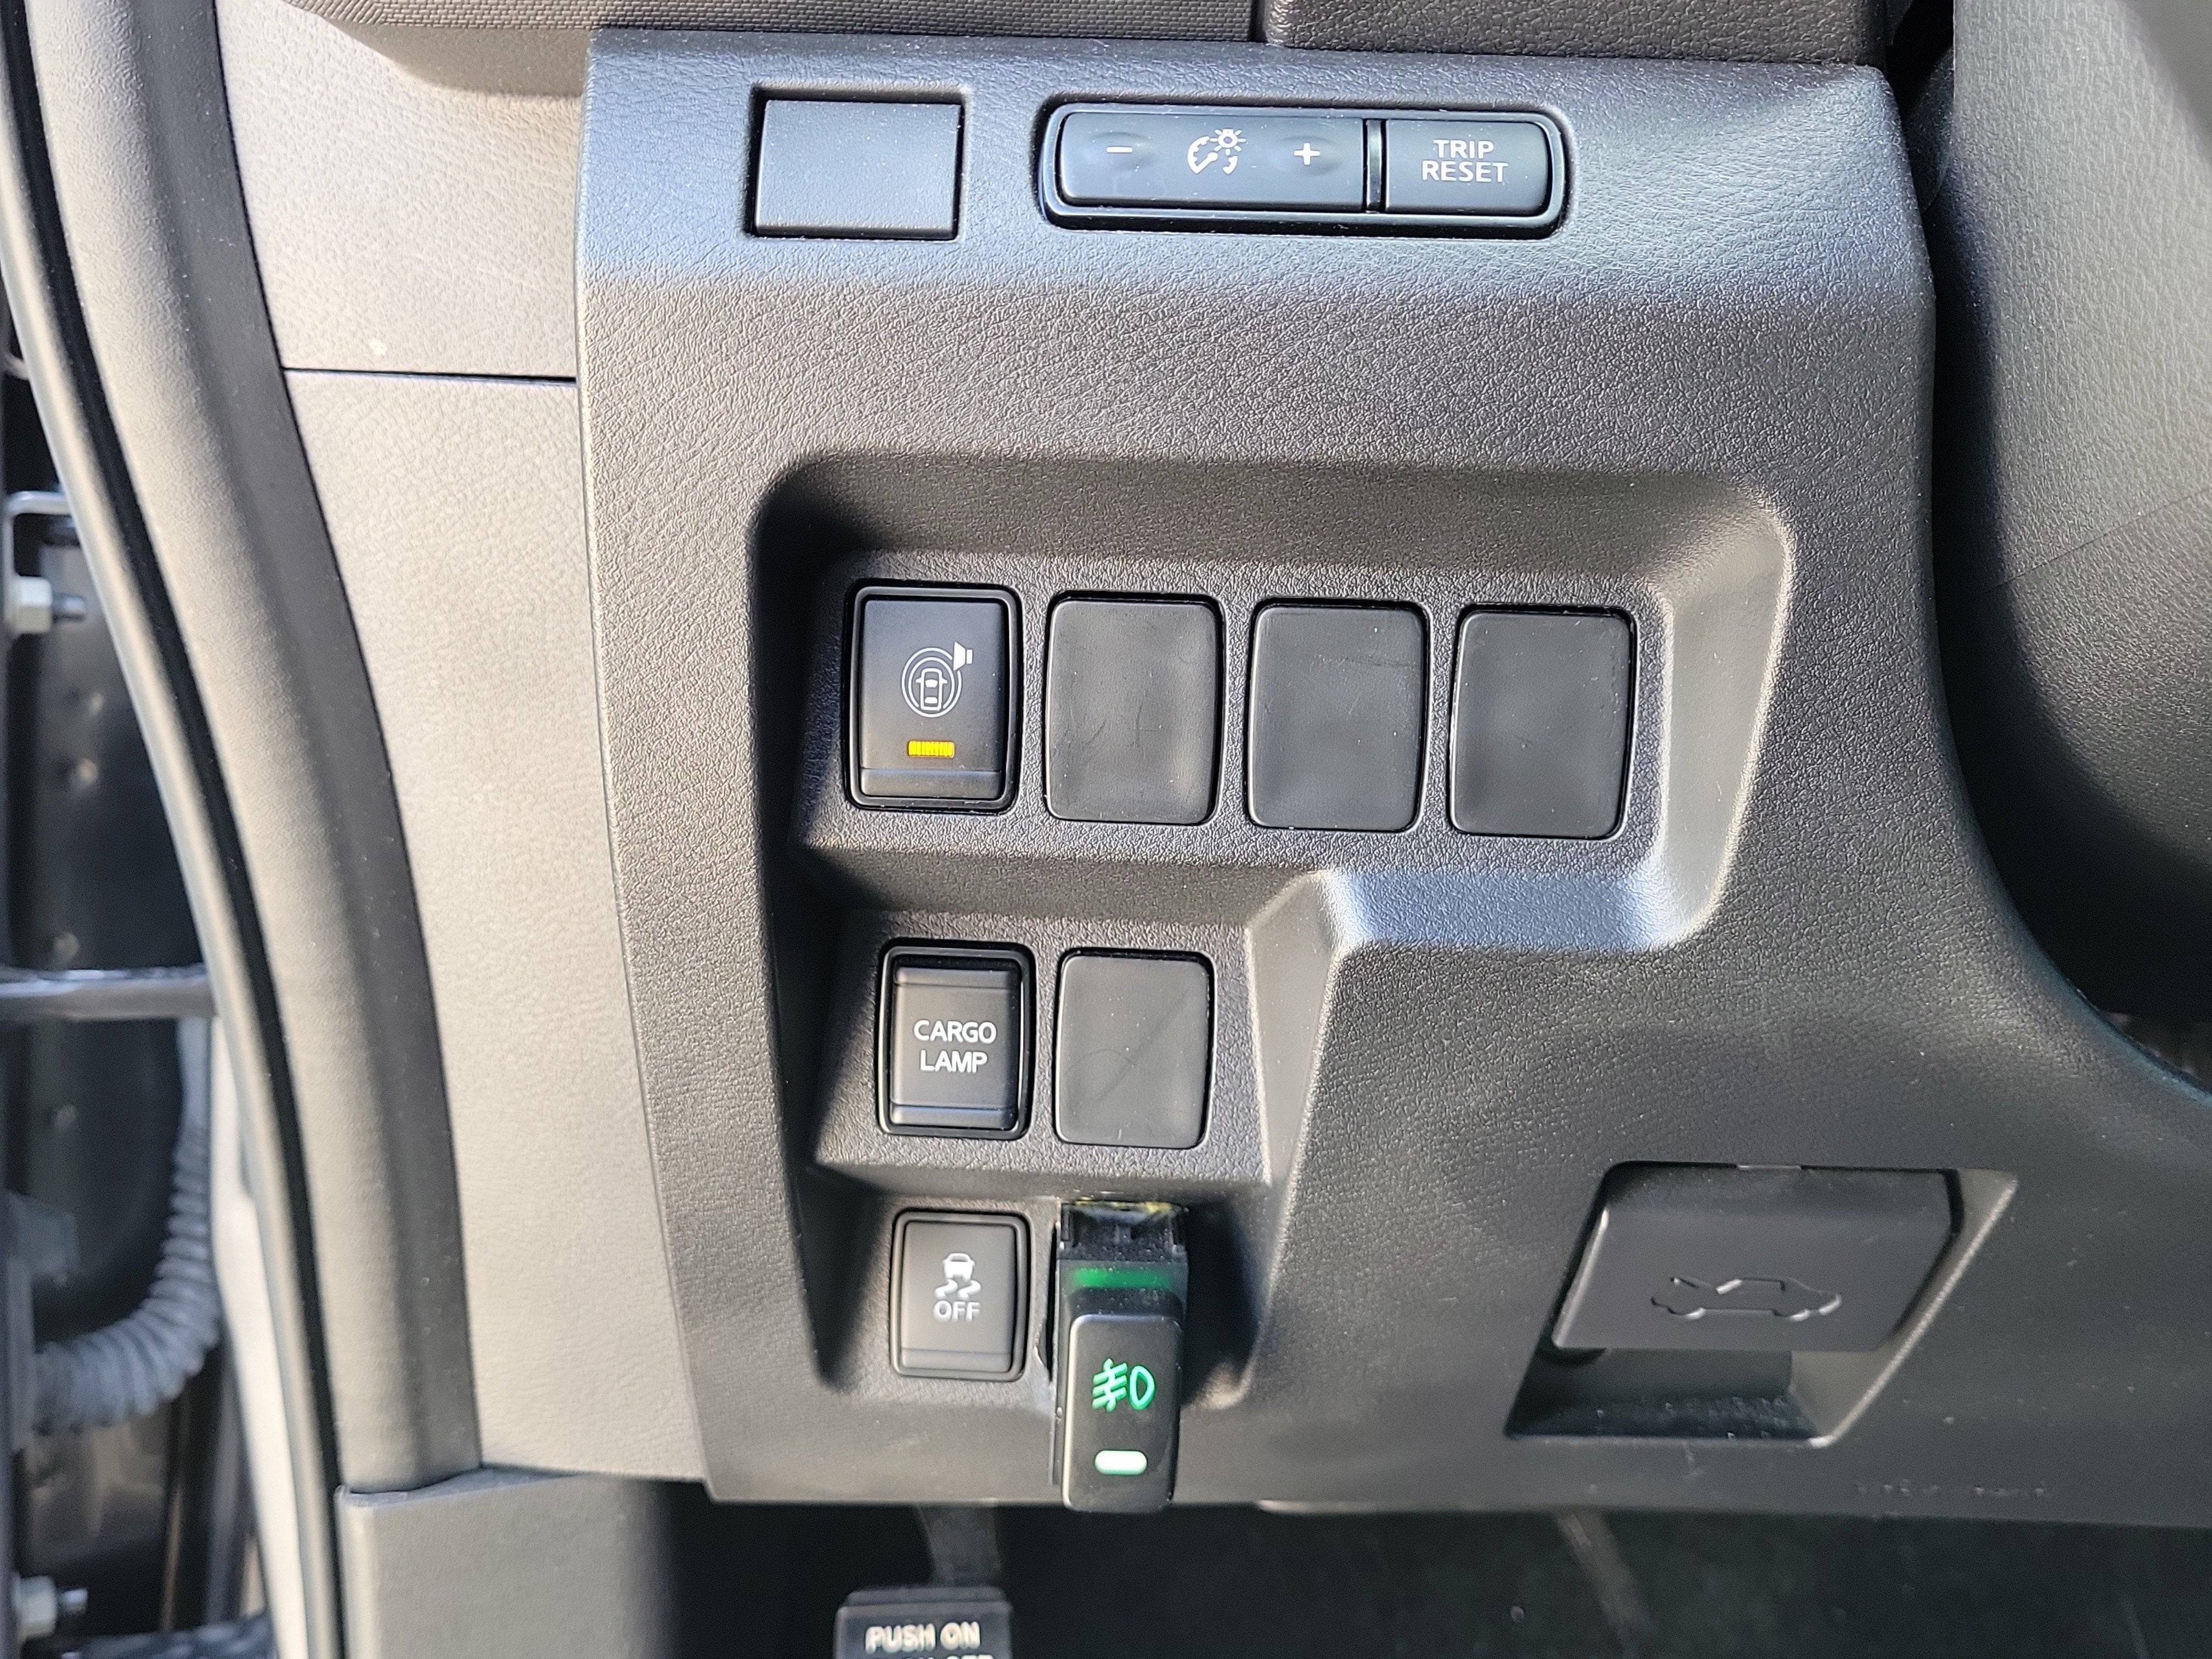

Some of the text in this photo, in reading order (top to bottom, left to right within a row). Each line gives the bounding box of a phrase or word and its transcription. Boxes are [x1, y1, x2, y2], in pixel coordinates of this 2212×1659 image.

[1433, 139, 1494, 159] TRIP
[1422, 160, 1509, 183] RESET
[913, 1020, 997, 1044] CARGO
[920, 1049, 988, 1073] LAMP
[933, 1300, 981, 1323] OFF
[865, 1621, 980, 1654] PUSH ON
